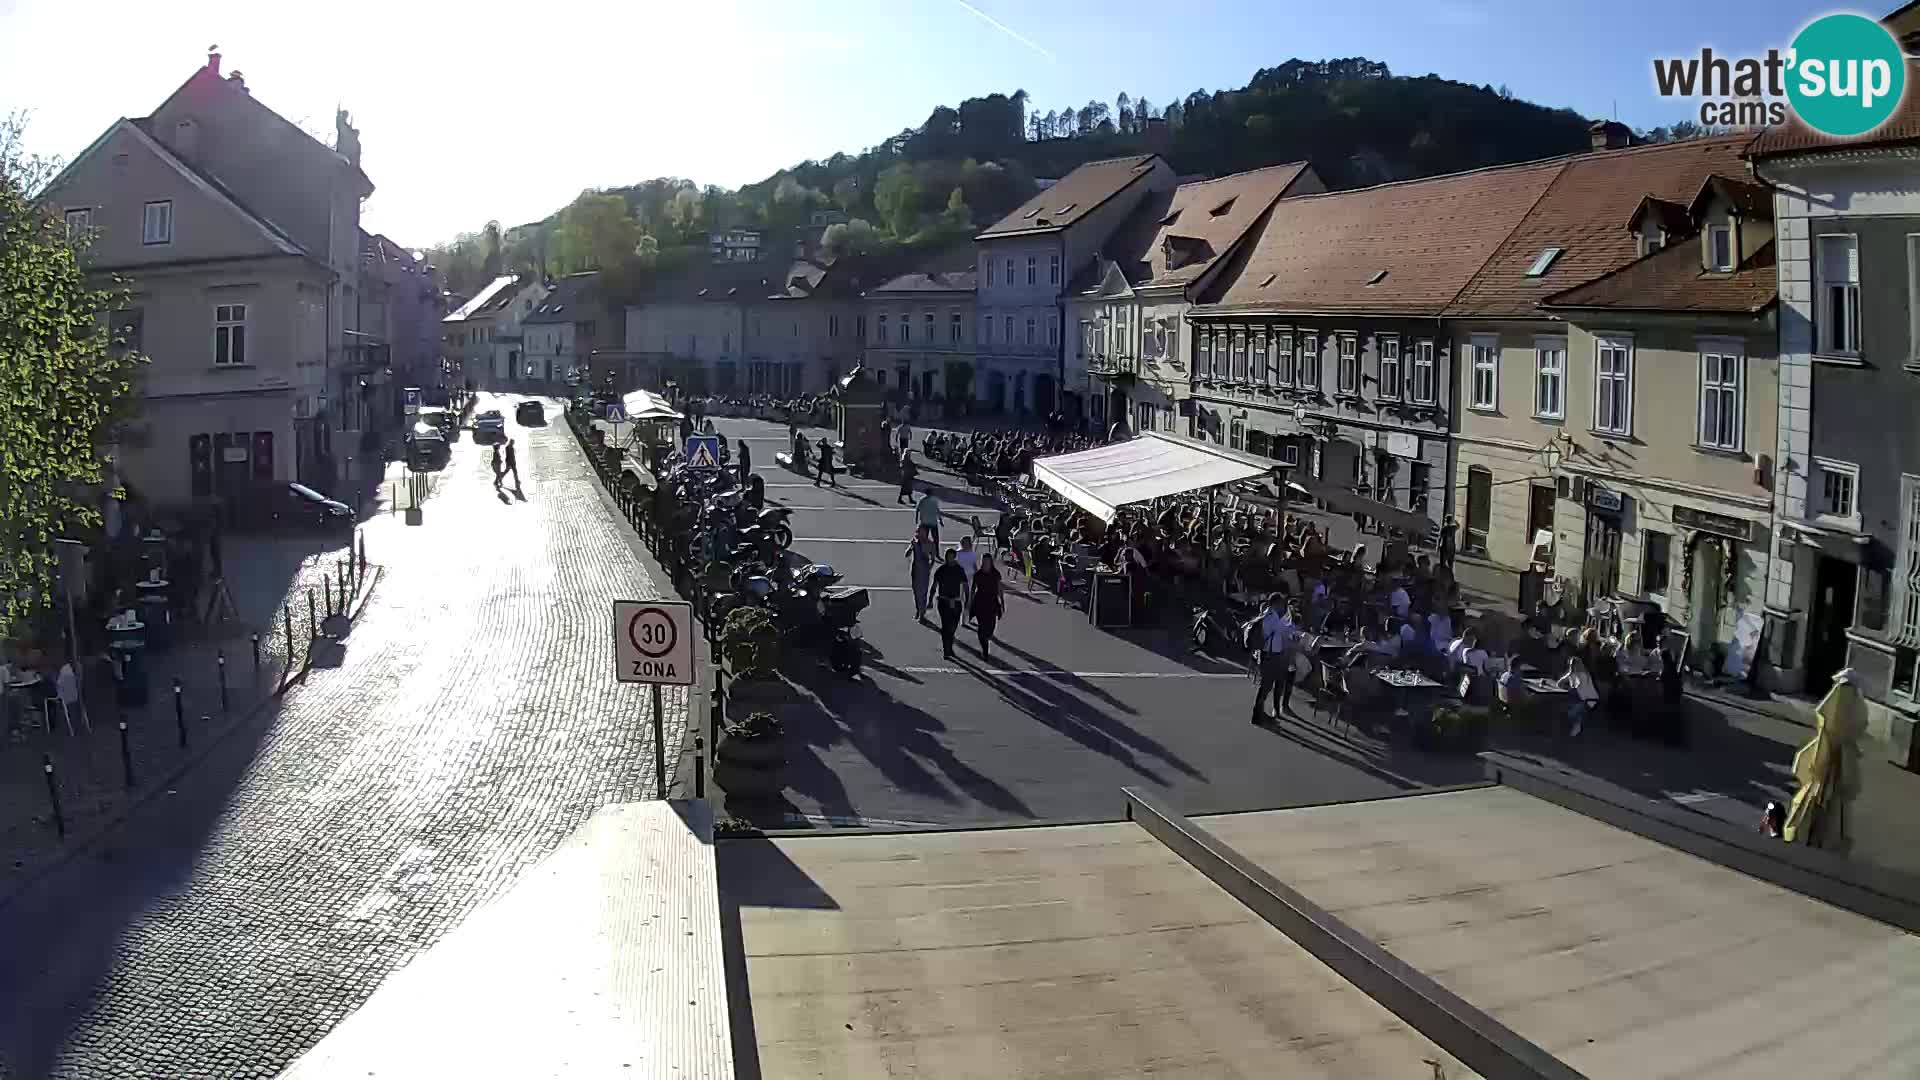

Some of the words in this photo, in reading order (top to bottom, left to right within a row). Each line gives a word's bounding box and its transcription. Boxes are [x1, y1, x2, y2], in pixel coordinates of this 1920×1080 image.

[408, 391, 416, 403] P
[642, 623, 666, 645] 30
[631, 660, 677, 678] ZONA
